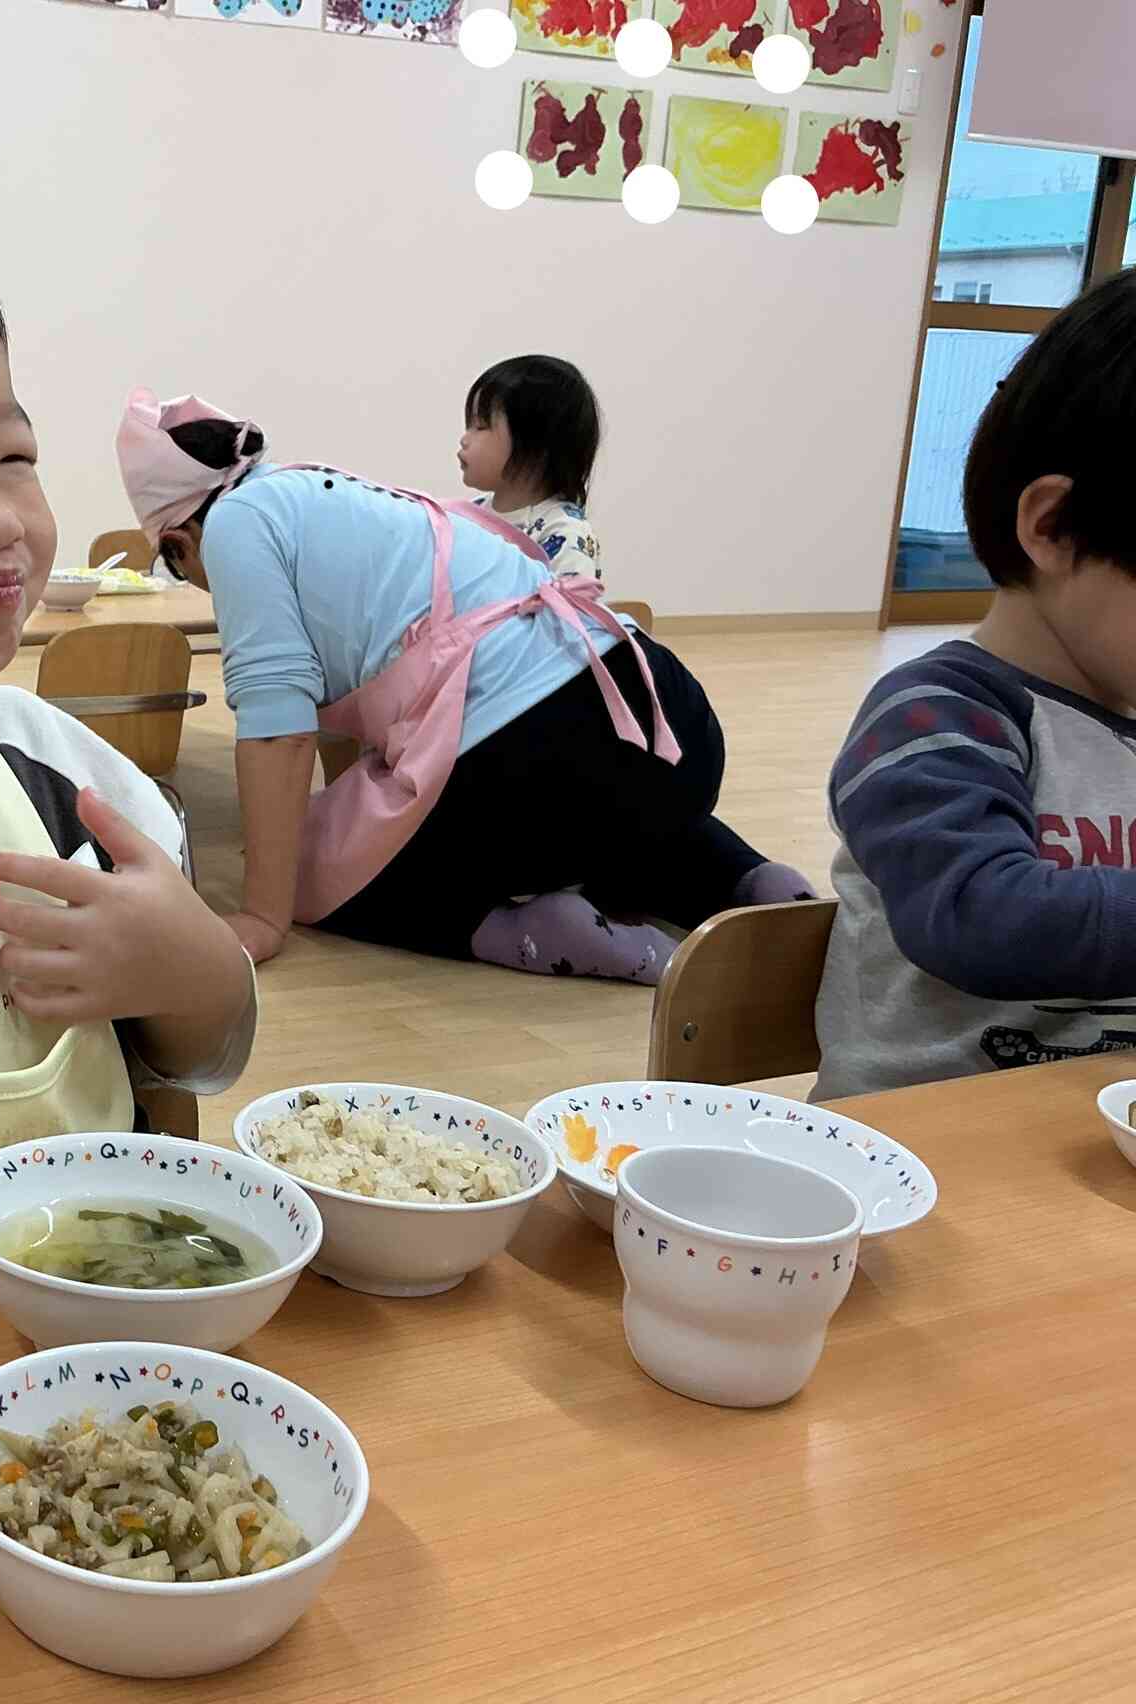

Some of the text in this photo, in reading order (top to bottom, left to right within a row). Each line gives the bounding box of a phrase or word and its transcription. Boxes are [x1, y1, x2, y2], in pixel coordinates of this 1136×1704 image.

[344, 1096, 359, 1112] X
[378, 1094, 391, 1107] Y
[405, 1096, 420, 1111] Z
[447, 1115, 458, 1130] A
[475, 1118, 486, 1132] B
[492, 1138, 503, 1150] C
[514, 1144, 522, 1160] D
[601, 1096, 610, 1110] R
[632, 1098, 643, 1111] S
[665, 1093, 676, 1104] T
[705, 1103, 717, 1116] U
[749, 1098, 761, 1111] V
[826, 1126, 839, 1139] X
[884, 1153, 899, 1165] Z
[3, 1160, 18, 1180] N
[32, 1148, 45, 1163] O
[64, 1152, 74, 1167] P
[100, 1143, 119, 1159] Q
[140, 1149, 154, 1165] R
[176, 1159, 188, 1174] S
[210, 1160, 222, 1176] T
[239, 1181, 252, 1199] U
[272, 1184, 284, 1201] V
[657, 1238, 669, 1256] F
[718, 1256, 732, 1272] G
[778, 1267, 796, 1285] H
[832, 1254, 841, 1272] I
[25, 1369, 37, 1391] L
[58, 1362, 76, 1384] M
[109, 1366, 131, 1390] N
[154, 1363, 172, 1381] O
[190, 1377, 204, 1395] P
[230, 1381, 251, 1405] Q
[270, 1404, 285, 1424] R
[298, 1428, 309, 1448] S
[324, 1440, 335, 1459] T
